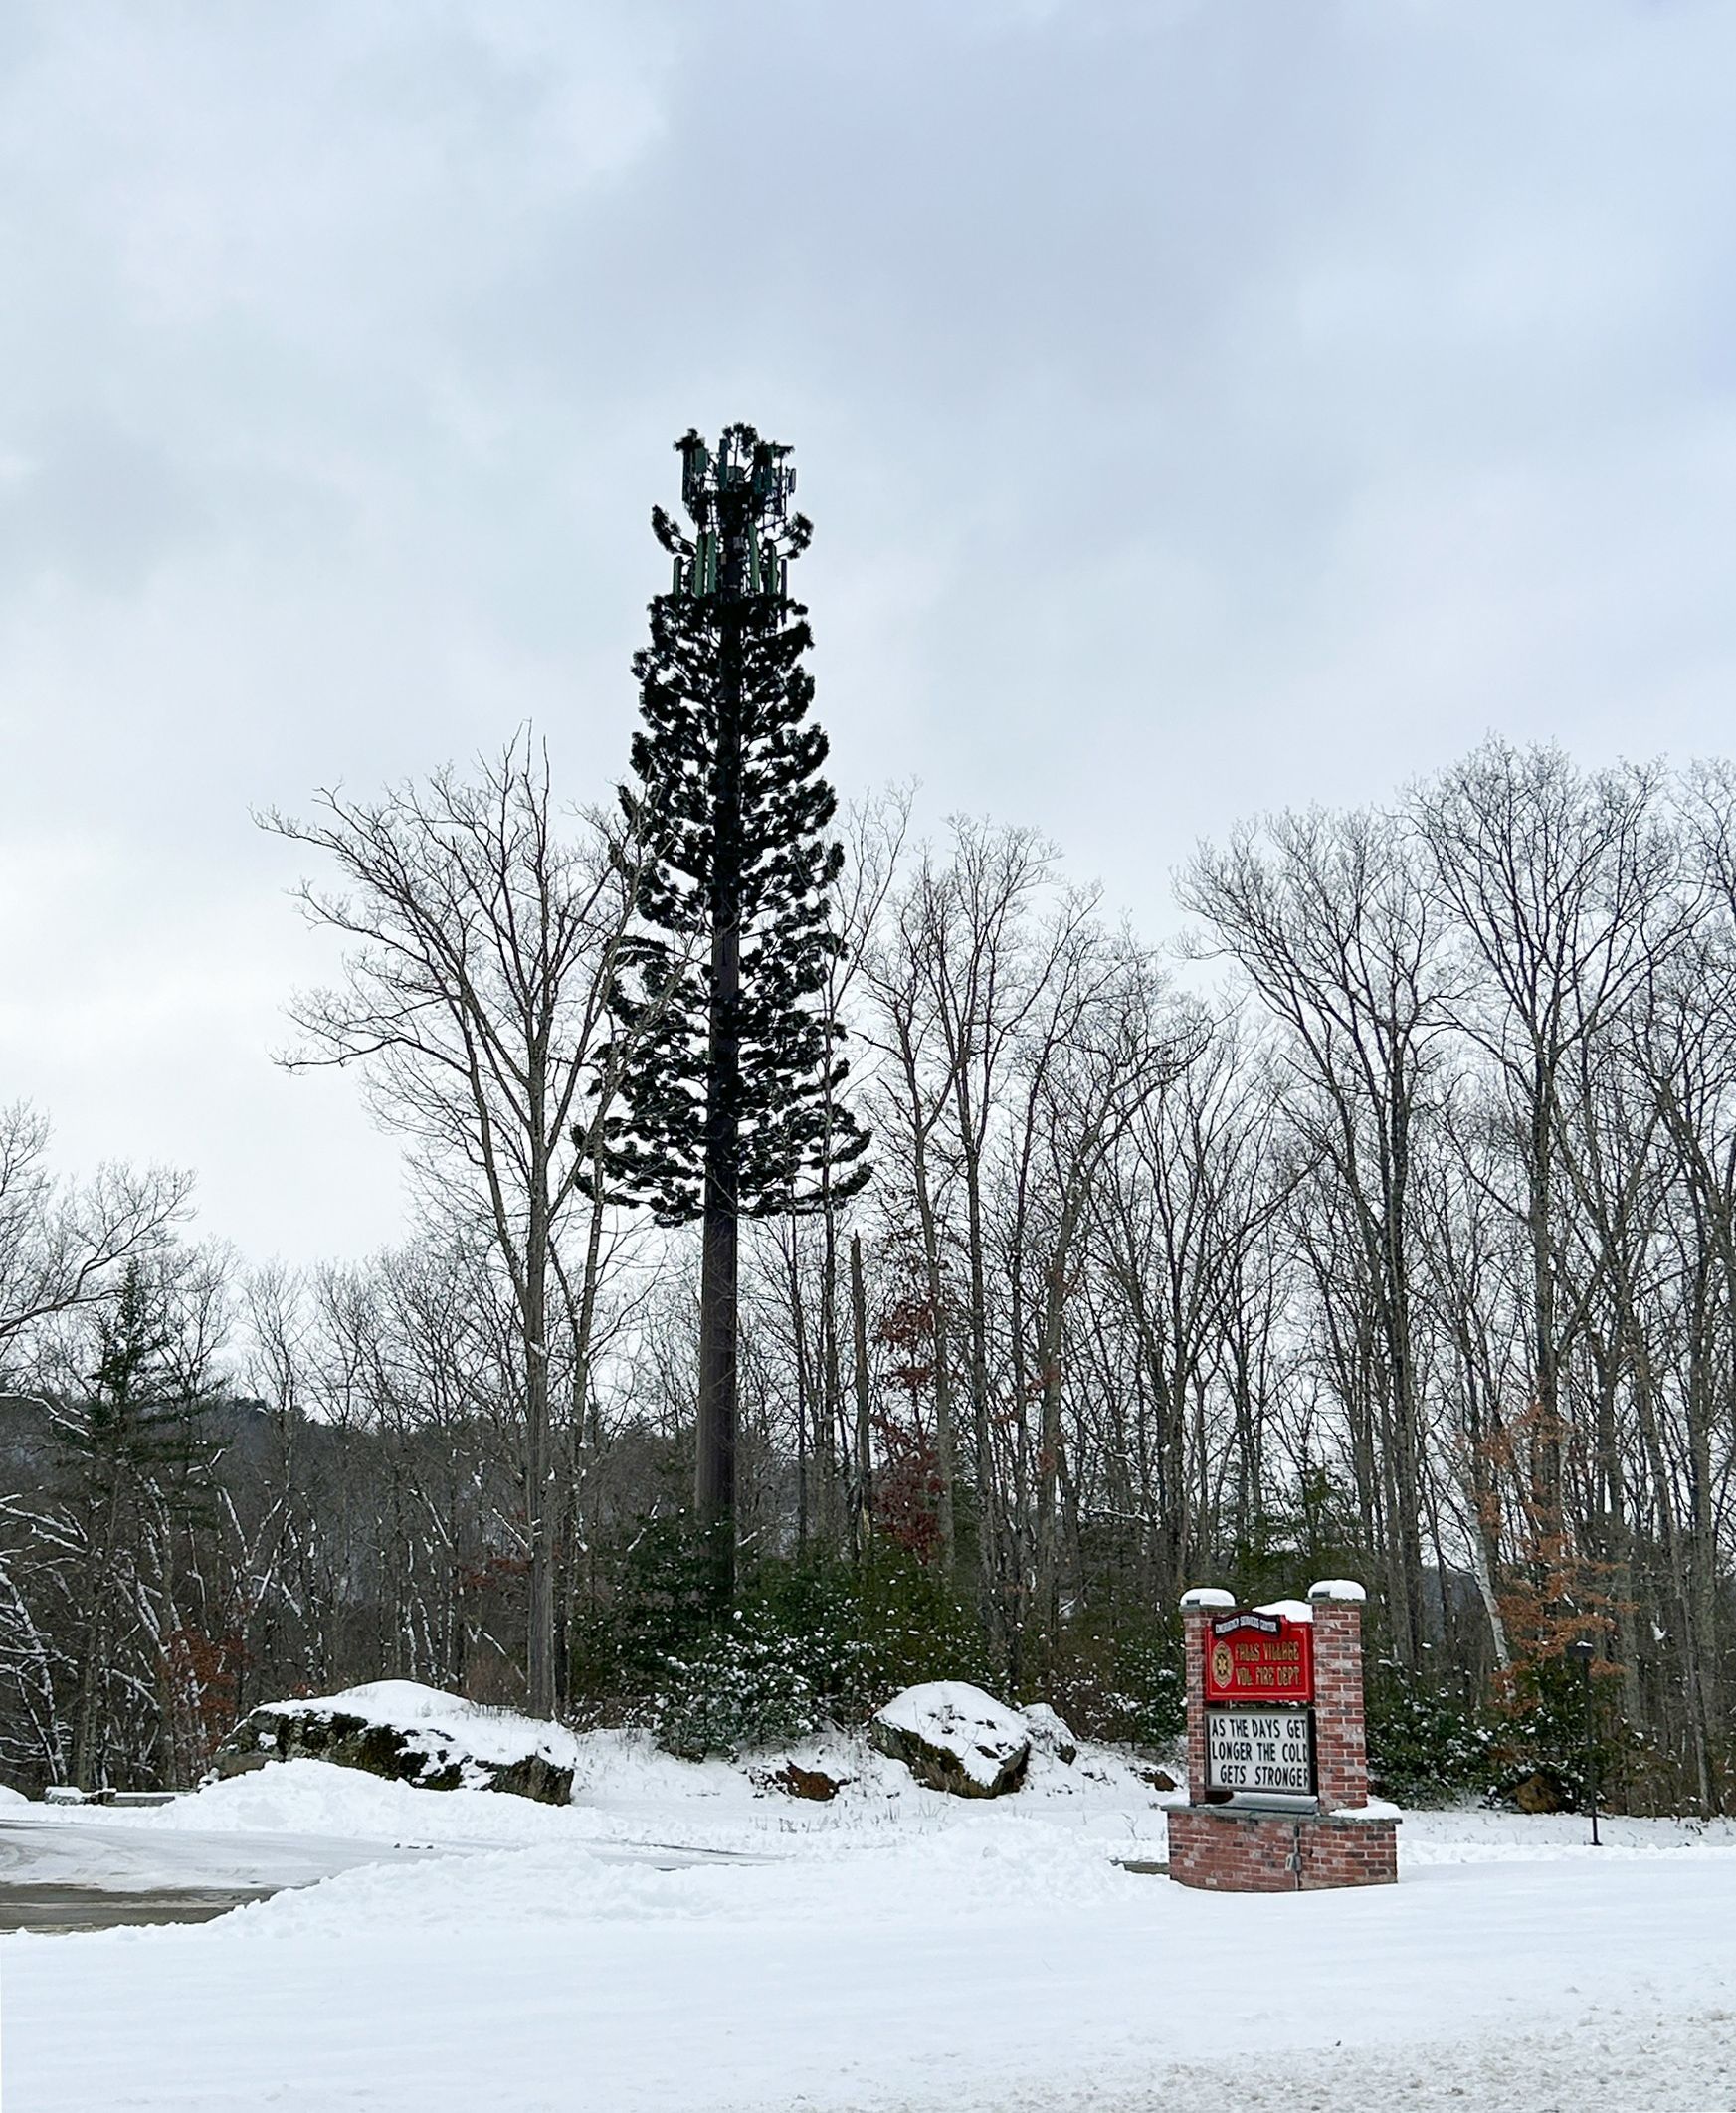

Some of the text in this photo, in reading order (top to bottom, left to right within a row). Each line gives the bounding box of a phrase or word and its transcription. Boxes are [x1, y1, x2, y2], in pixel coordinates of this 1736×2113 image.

[1263, 1641, 1299, 1661] VILLAGE
[1255, 1666, 1274, 1686] FIRE
[1212, 1718, 1306, 1739] AS THE DAYS GET
[1212, 1741, 1252, 1761] LONGER
[1256, 1743, 1276, 1761] THE
[1220, 1765, 1247, 1784] GETS
